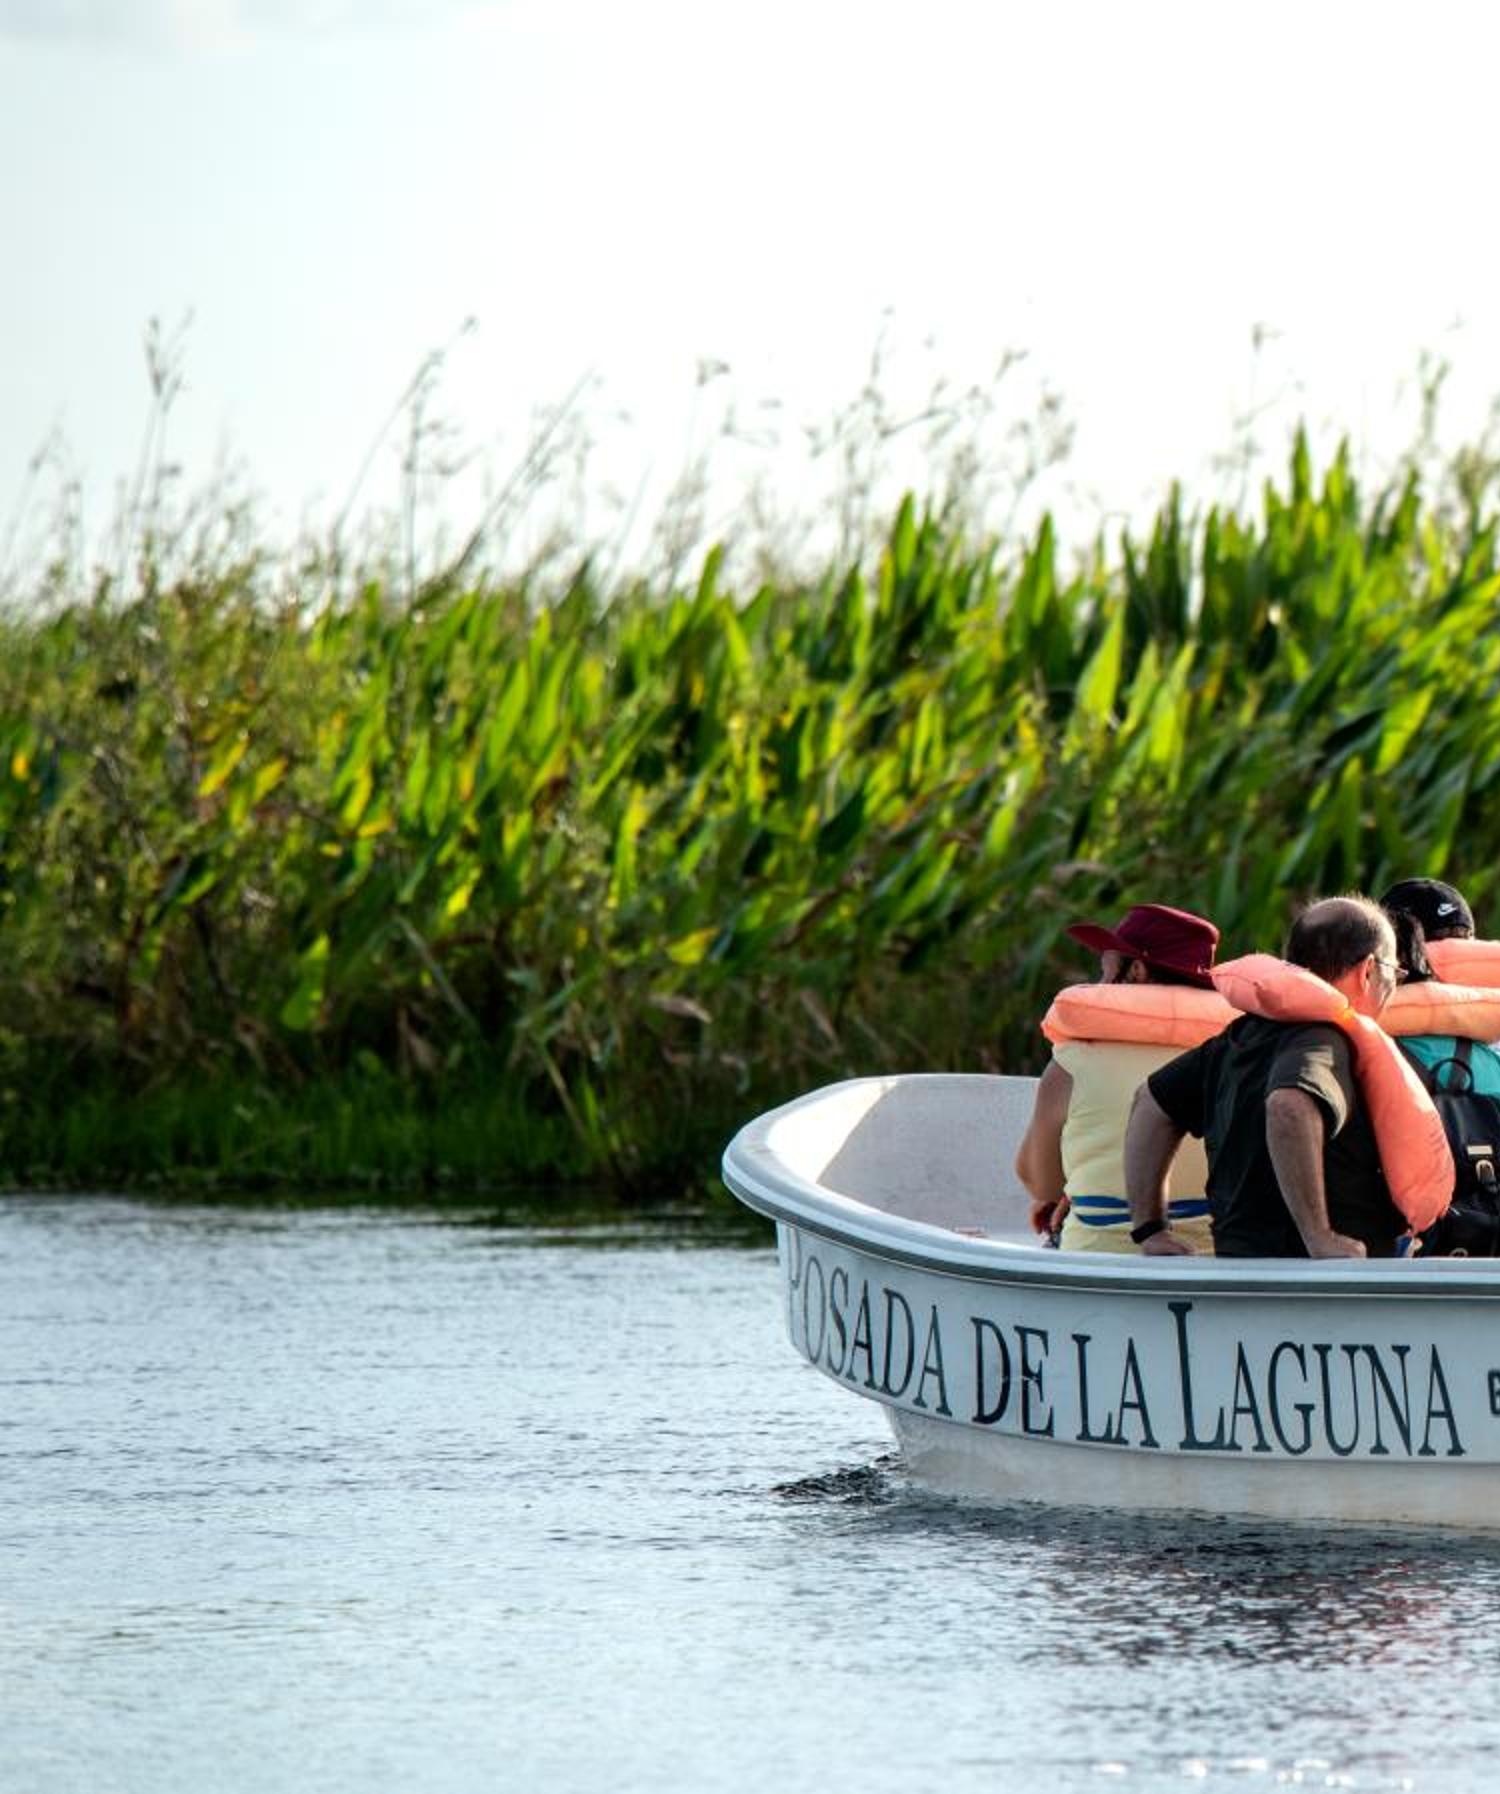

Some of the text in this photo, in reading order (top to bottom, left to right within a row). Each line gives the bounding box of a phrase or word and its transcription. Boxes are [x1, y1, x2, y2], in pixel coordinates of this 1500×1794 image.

[788, 1226, 1466, 1457] POSADA DE LA LAGUNA
